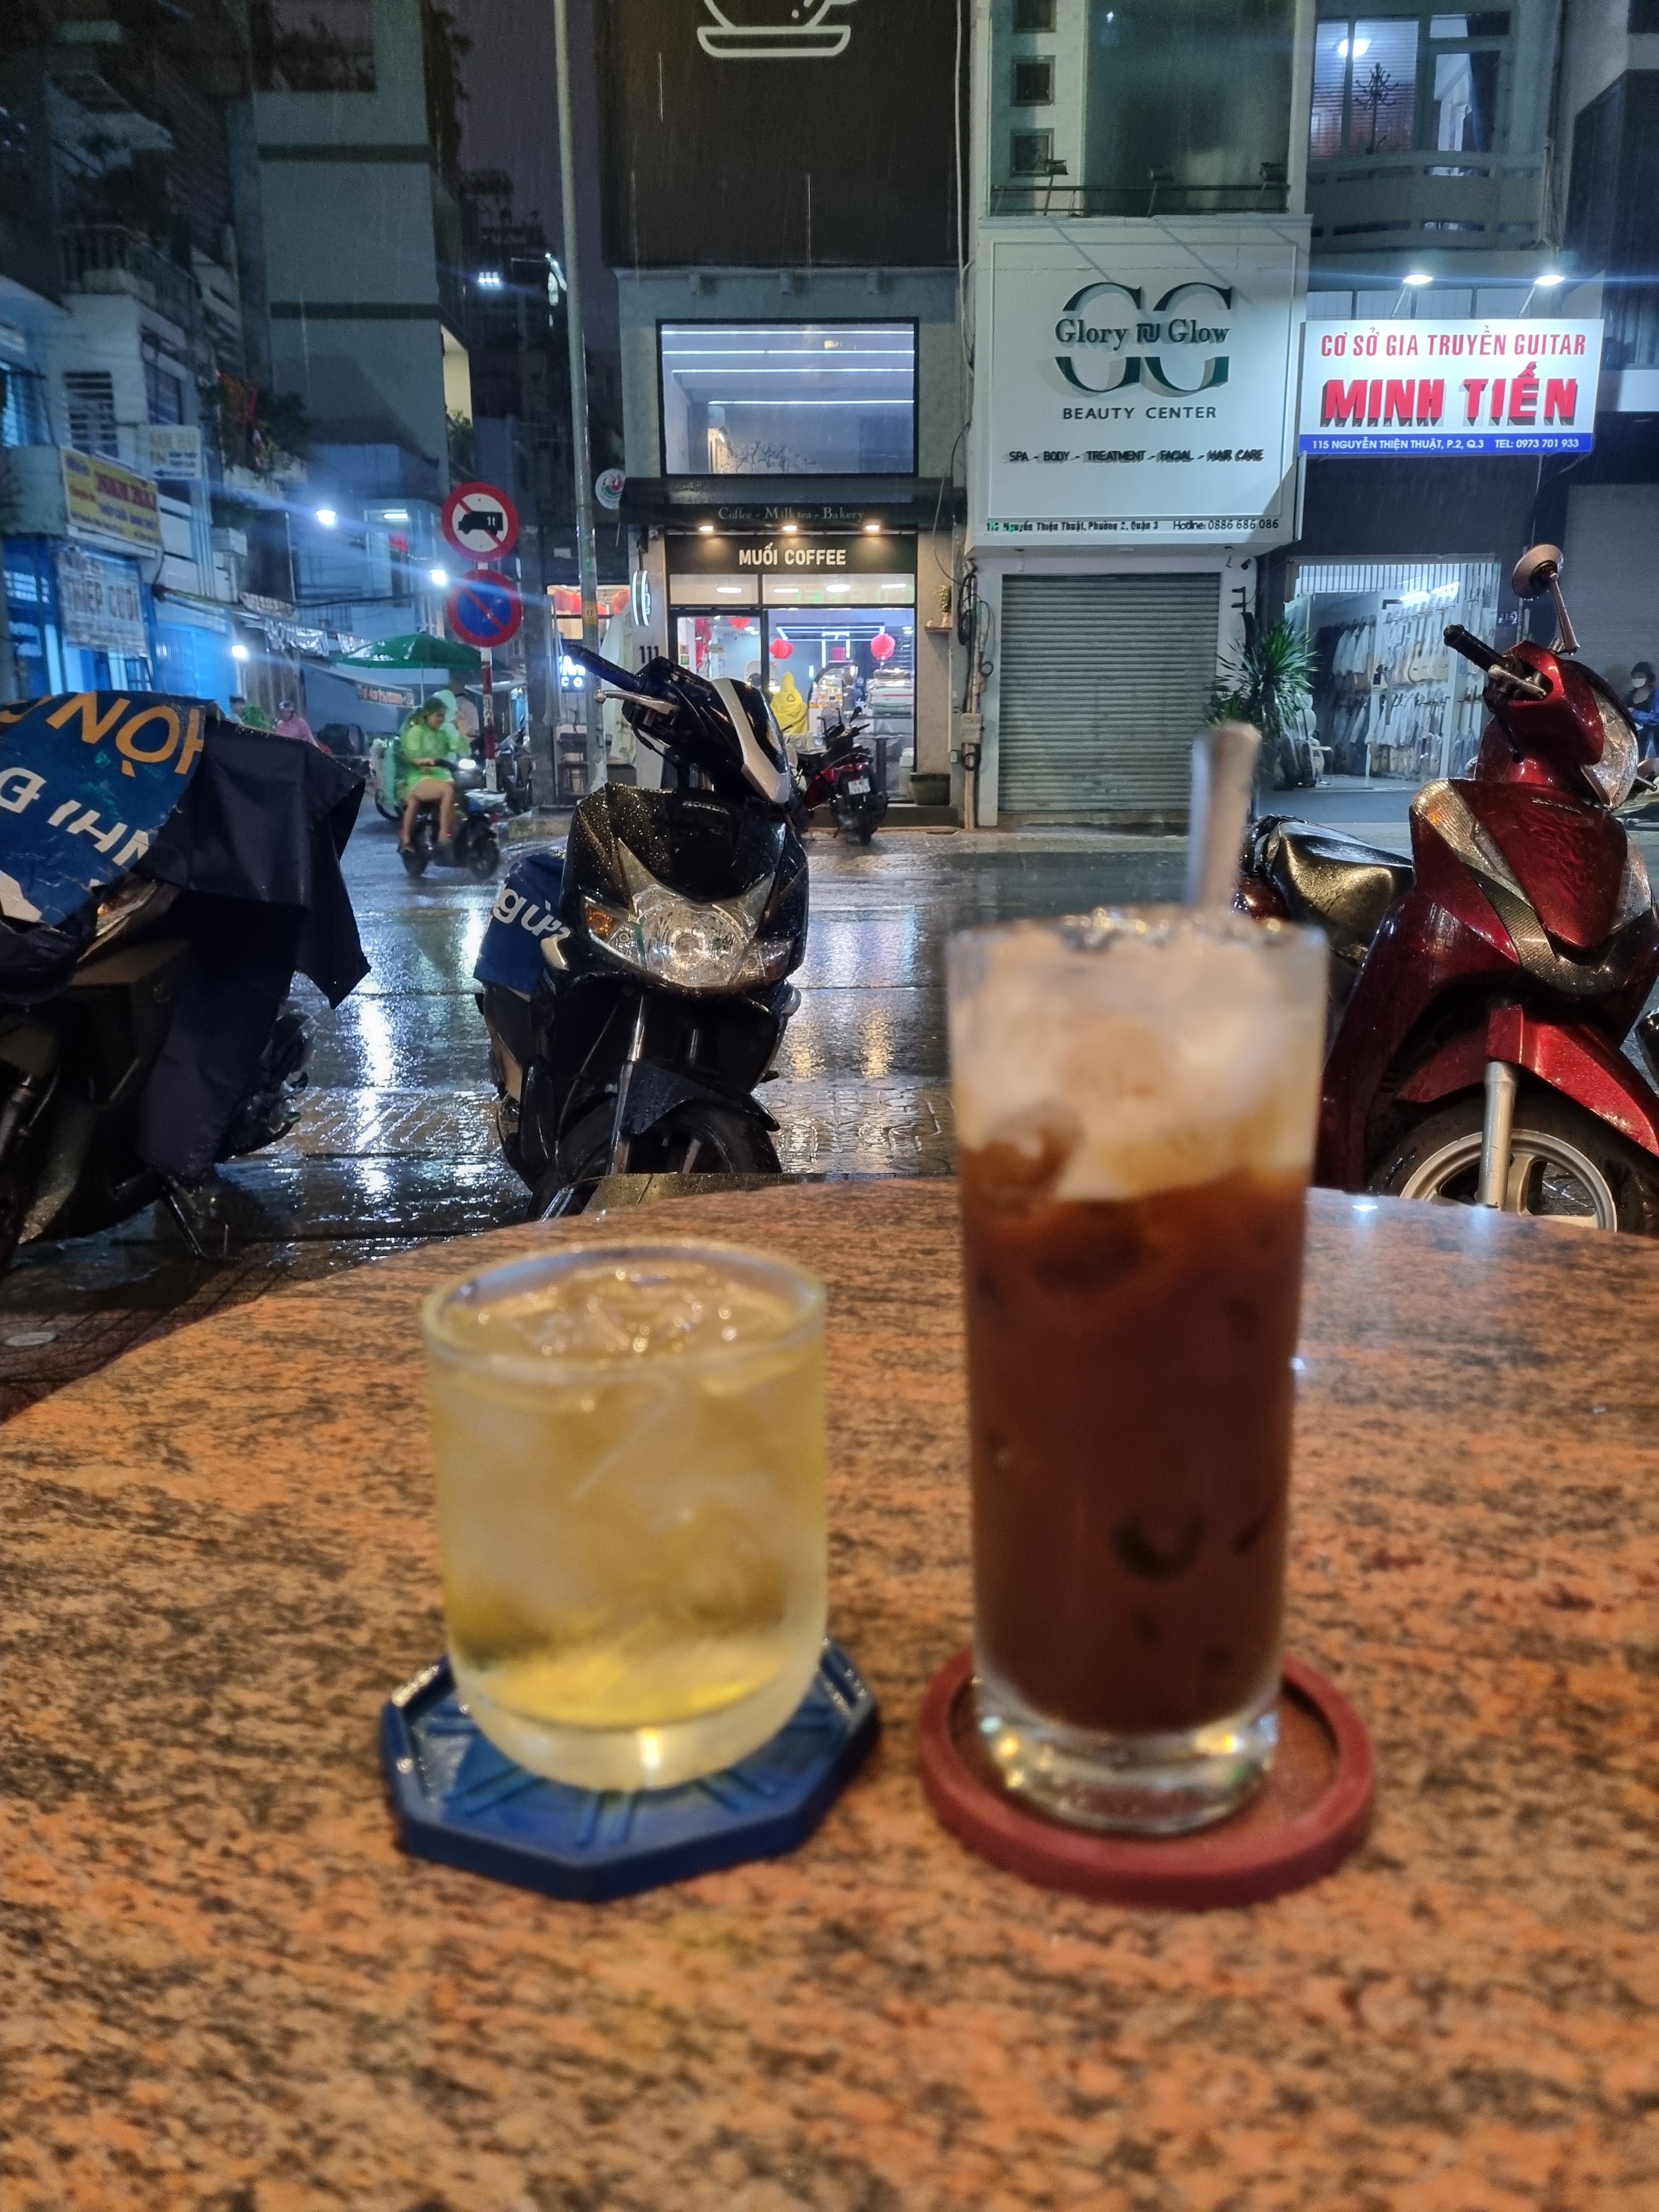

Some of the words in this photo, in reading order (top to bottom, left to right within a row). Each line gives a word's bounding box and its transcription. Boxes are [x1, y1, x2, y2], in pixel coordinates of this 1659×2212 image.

[1055, 319, 1128, 351] Glory
[1167, 319, 1231, 343] Glow
[1321, 332, 1348, 357] CƠ
[1353, 328, 1379, 357] SỞ
[1385, 334, 1419, 357] GIA
[1427, 325, 1506, 356] TRUYỀN
[1514, 334, 1587, 356] GUITAR
[1321, 379, 1446, 424] MINH
[1461, 362, 1578, 422] TIẾN
[1063, 407, 1135, 420] BEAUTY
[1146, 406, 1217, 419] CENTER
[1313, 440, 1329, 449] 115
[1331, 436, 1376, 449] NGUYỄN
[1379, 438, 1408, 450] THIỆN
[1410, 438, 1444, 450] THUẬT,
[1466, 439, 1485, 448] Q.3
[1495, 439, 1514, 448] TEL:
[1516, 439, 1540, 448] 0973
[1542, 439, 1558, 448] 701
[1561, 439, 1579, 448] 933
[1009, 450, 1029, 461] SPA
[1044, 450, 1070, 461] BODY
[1086, 449, 1146, 461] TREATMENT
[1159, 449, 1193, 461] FACIAL
[1206, 449, 1233, 461] HAIR
[1235, 449, 1264, 461] CARE
[718, 506, 752, 520] Coffee
[822, 506, 864, 522] Bakery
[1208, 520, 1233, 530] 0886
[1236, 519, 1256, 529] 686
[1259, 518, 1279, 529] 086
[739, 541, 778, 566] MUỐI
[784, 549, 847, 566] COFFEE
[639, 645, 659, 664] 111
